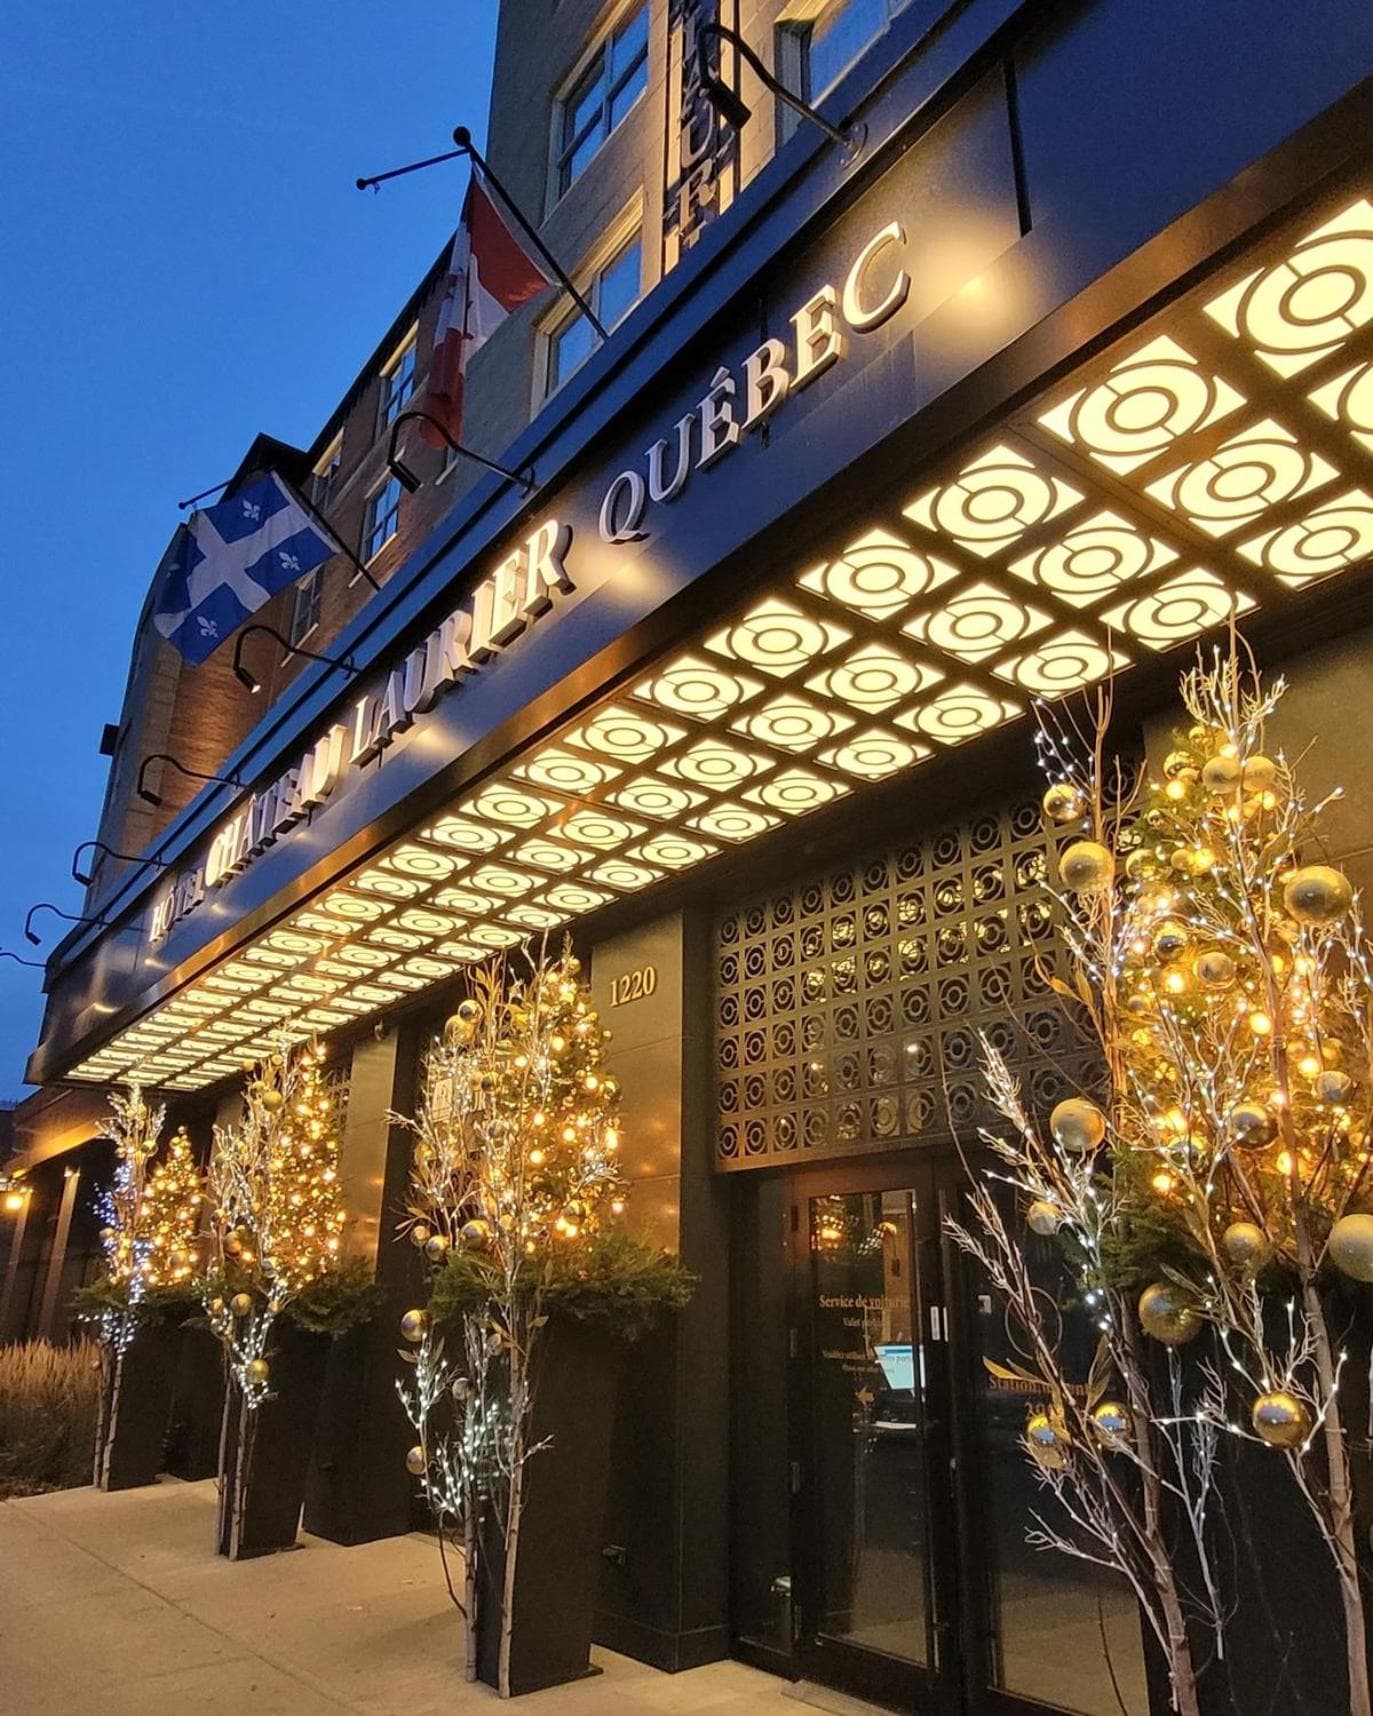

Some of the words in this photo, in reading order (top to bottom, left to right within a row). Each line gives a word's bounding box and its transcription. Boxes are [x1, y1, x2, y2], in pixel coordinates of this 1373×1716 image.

[205, 724, 348, 888] CHÂTEAU
[349, 519, 575, 766] LAURIER
[599, 221, 911, 543] QUÉBEC
[609, 966, 656, 1008] 1220
[819, 1294, 854, 1308] Service
[855, 1293, 868, 1308] de
